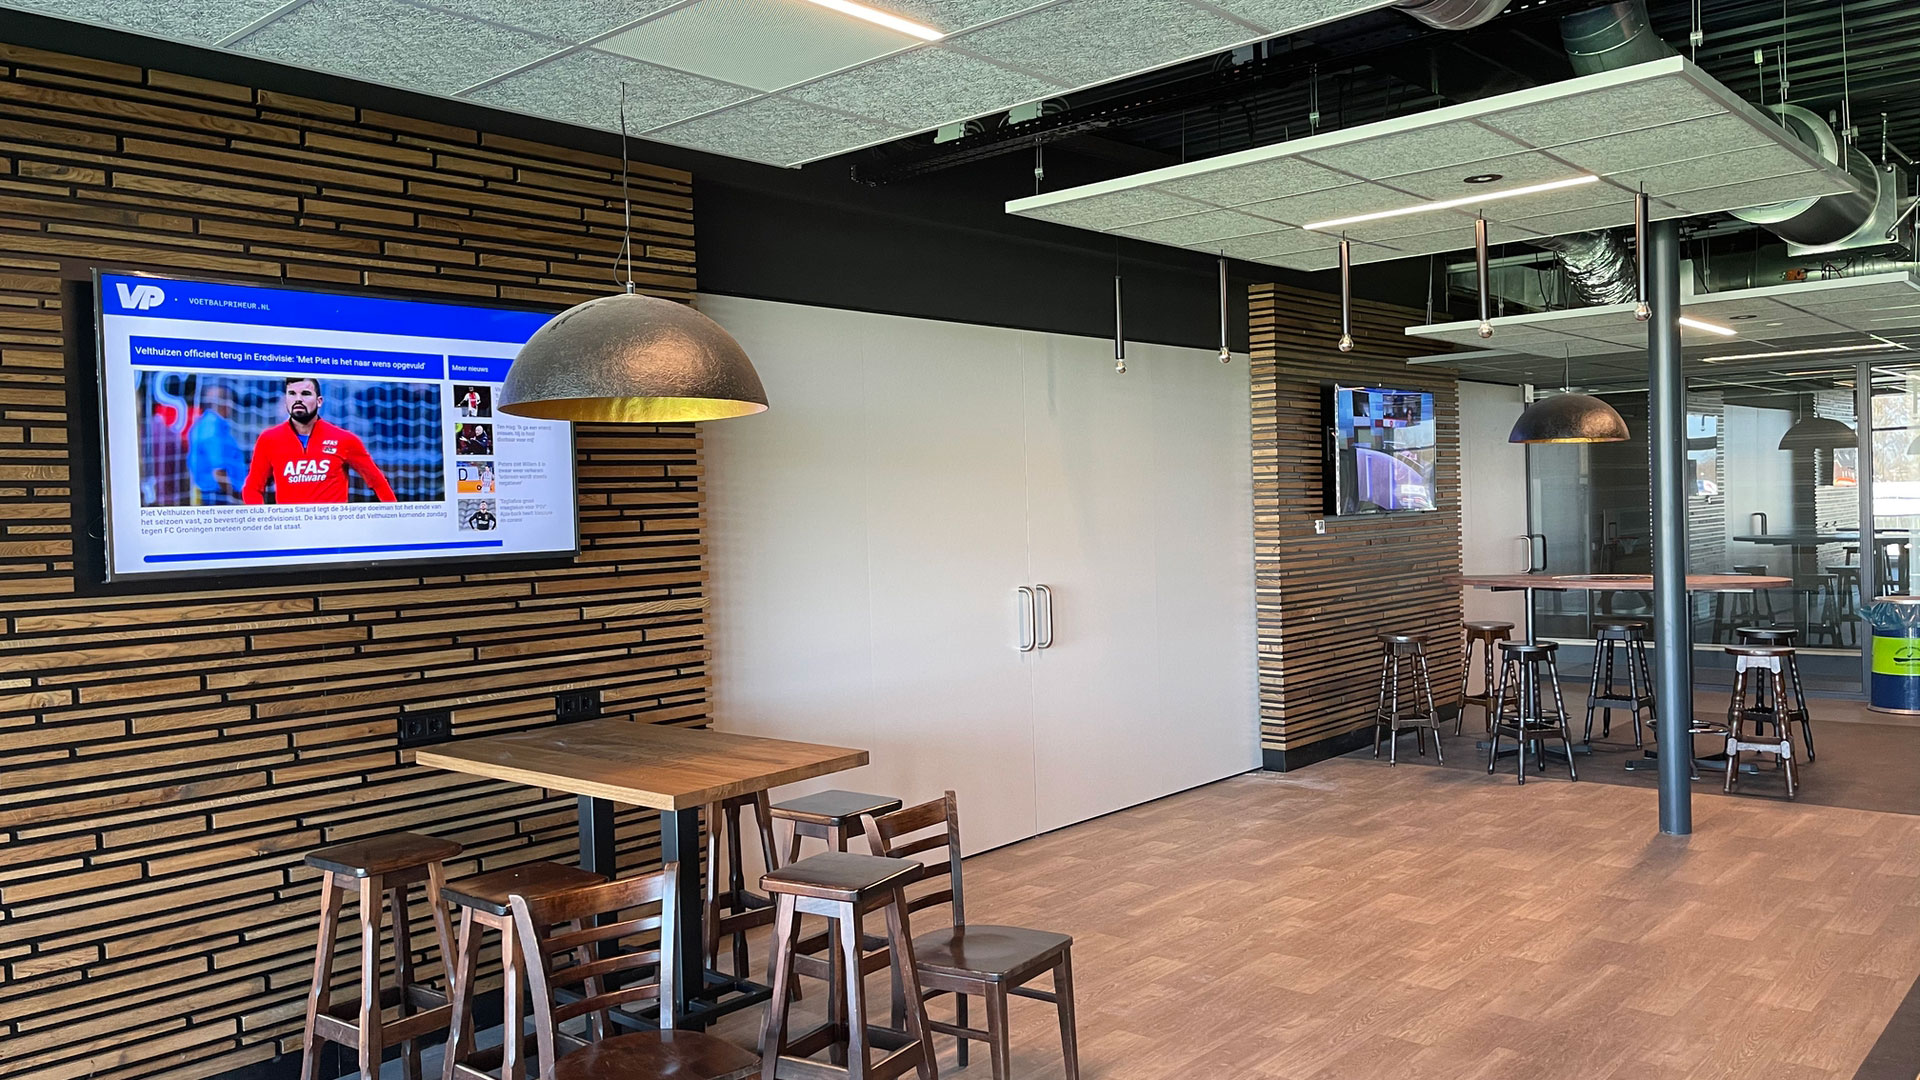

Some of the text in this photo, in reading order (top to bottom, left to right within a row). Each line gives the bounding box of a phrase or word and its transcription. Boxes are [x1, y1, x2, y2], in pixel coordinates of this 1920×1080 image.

[116, 283, 270, 310] VP VOETBALPRIMEUR.NL
[134, 346, 182, 357] Velthuizen
[184, 349, 218, 359] officieel
[220, 352, 242, 362] terug
[244, 352, 252, 360] in
[254, 352, 295, 363] Eredivisie:
[296, 355, 313, 364] 'Met
[315, 356, 330, 365] Piet
[332, 357, 338, 365] is
[340, 358, 352, 366] het
[372, 360, 391, 368] wens
[393, 362, 426, 370] opgevuld'
[452, 364, 467, 372] Meer
[284, 460, 330, 476] AFAS
[288, 474, 326, 483] software
[338, 513, 354, 521] groot
[427, 511, 447, 519] zondag
[176, 526, 213, 534] Groningen
